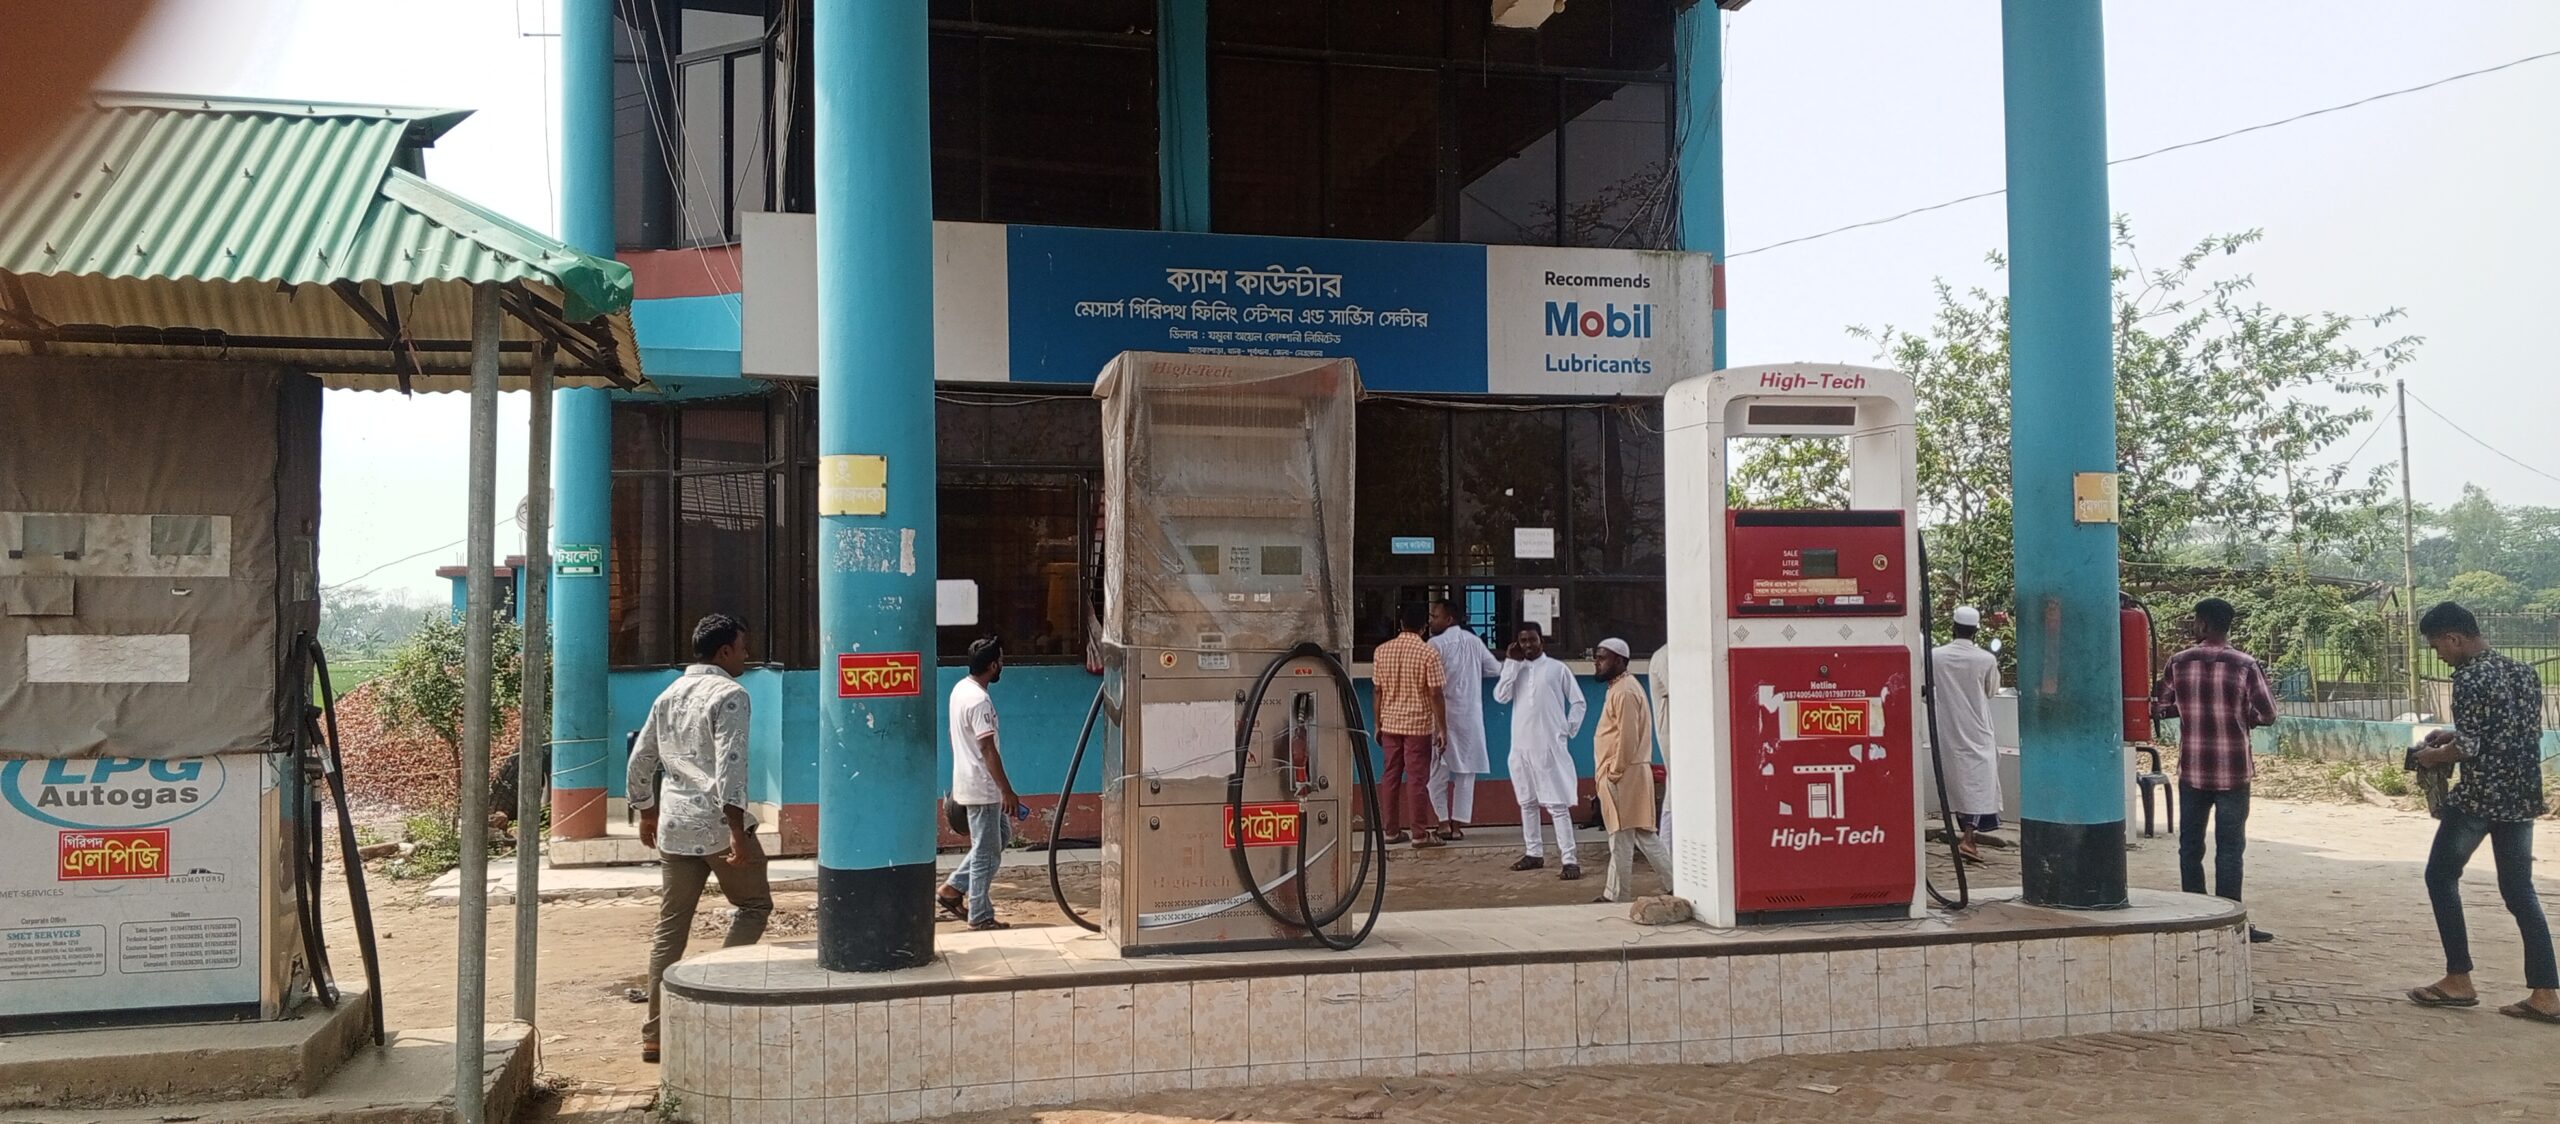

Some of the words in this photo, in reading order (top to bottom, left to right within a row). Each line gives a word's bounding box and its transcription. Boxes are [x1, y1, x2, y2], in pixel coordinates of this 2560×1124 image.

[1166, 268, 1228, 294] ক্যাশ
[1234, 265, 1342, 297] কাউন্টার
[1545, 271, 1651, 288] Recommends
[1075, 299, 1124, 318] মেসার্স
[1129, 297, 1186, 320] গিরিপথ
[1191, 300, 1238, 323] ফিলিং
[1243, 304, 1293, 323] স্টেশন
[1329, 305, 1374, 326] সার্ভিস
[1379, 308, 1428, 327] সেন্টার
[1545, 301, 1651, 338] Mobil
[1169, 327, 1198, 340] ডিলার
[1207, 331, 1233, 343] যমুনা
[1304, 331, 1341, 344] লিমিটেড
[1152, 361, 1232, 378] High-Tech
[1546, 353, 1651, 374] Lubricants
[1760, 372, 1866, 391] High-Tech
[841, 658, 917, 690] অকটেন
[1810, 681, 1837, 690] Hotline
[1802, 702, 1864, 734] পেট্রোল
[42, 756, 204, 785] LPG
[37, 785, 199, 809] Autogas
[1229, 807, 1298, 841] পেট্রোল
[1771, 826, 1885, 850] High-Tech
[64, 839, 161, 874] এলপিজি
[20, 888, 65, 898] SERVICES
[34, 930, 81, 939] SERVICES
